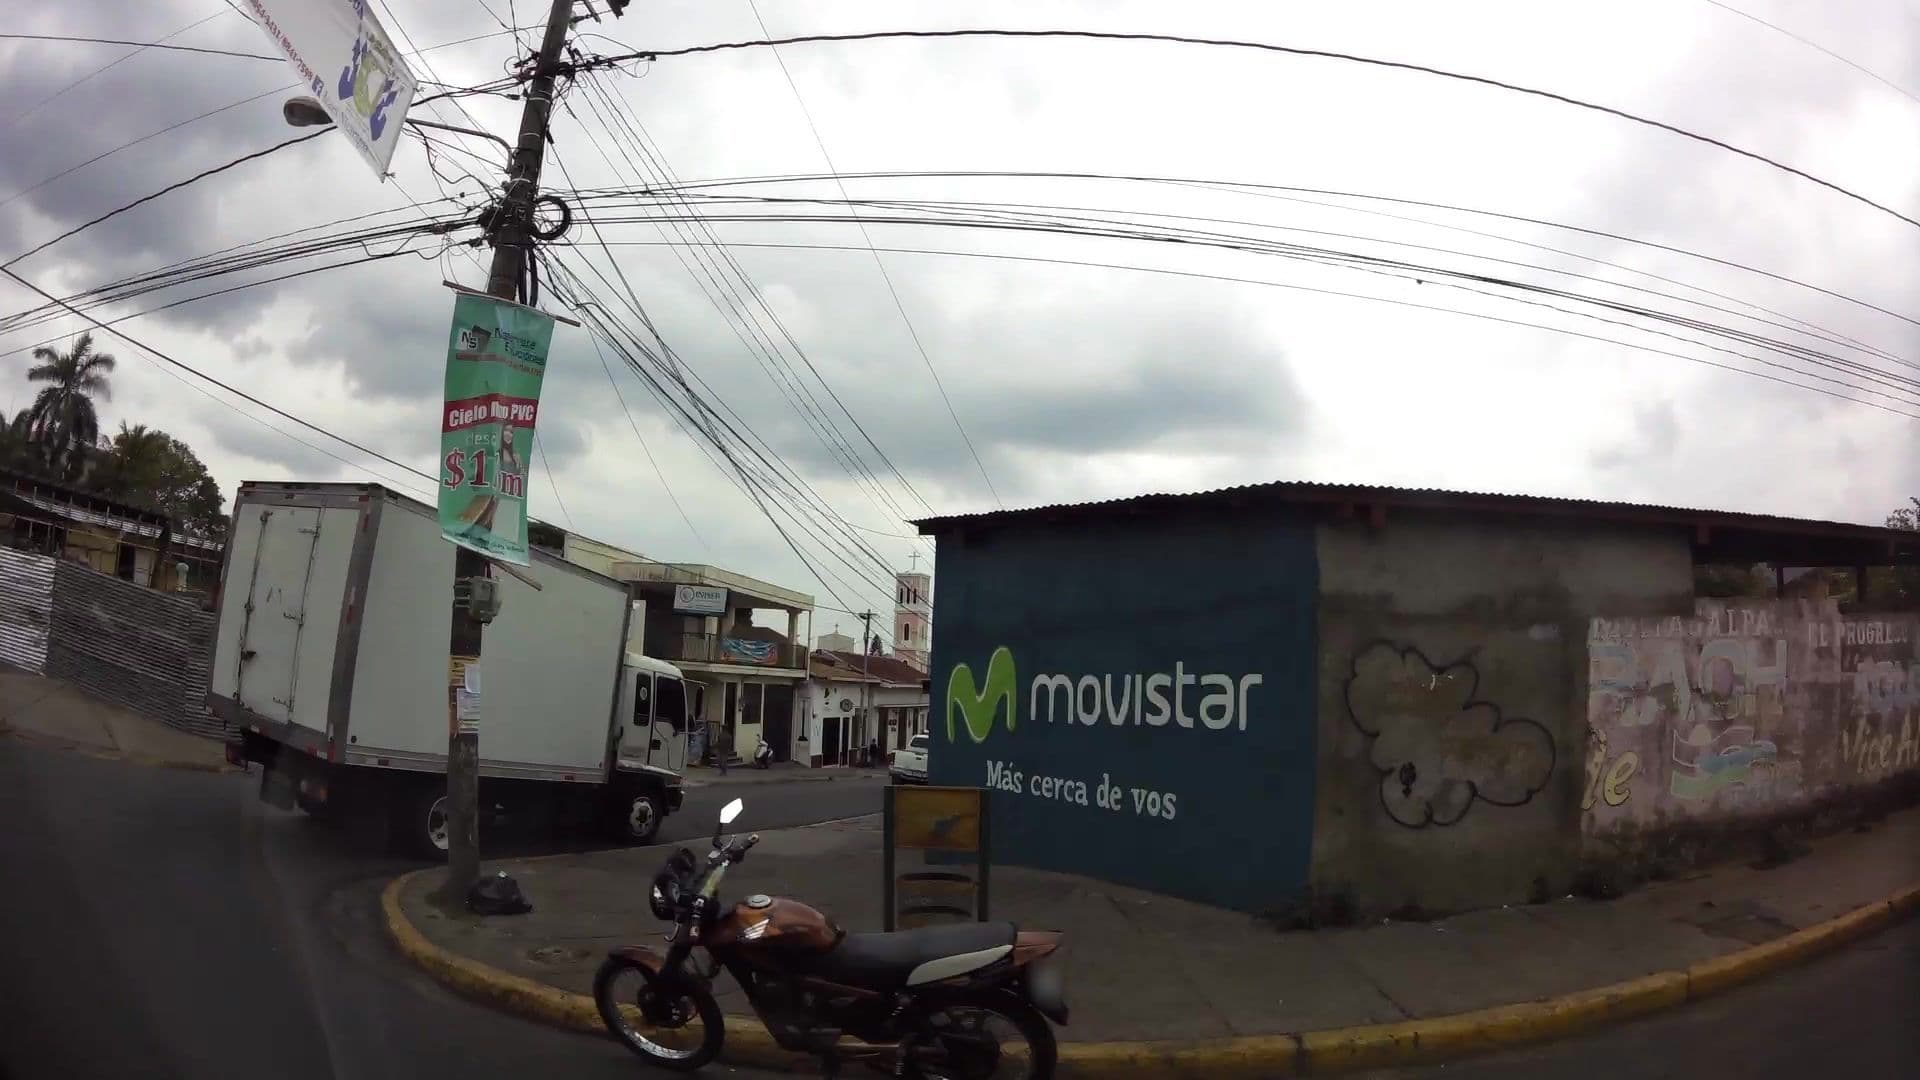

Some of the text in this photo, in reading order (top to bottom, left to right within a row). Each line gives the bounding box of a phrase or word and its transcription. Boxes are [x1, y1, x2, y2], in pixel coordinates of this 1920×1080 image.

[449, 405, 487, 427] Cielo
[511, 403, 534, 421] PVC
[1030, 661, 1263, 731] movistar
[985, 759, 1178, 820] Más cerca de vos
